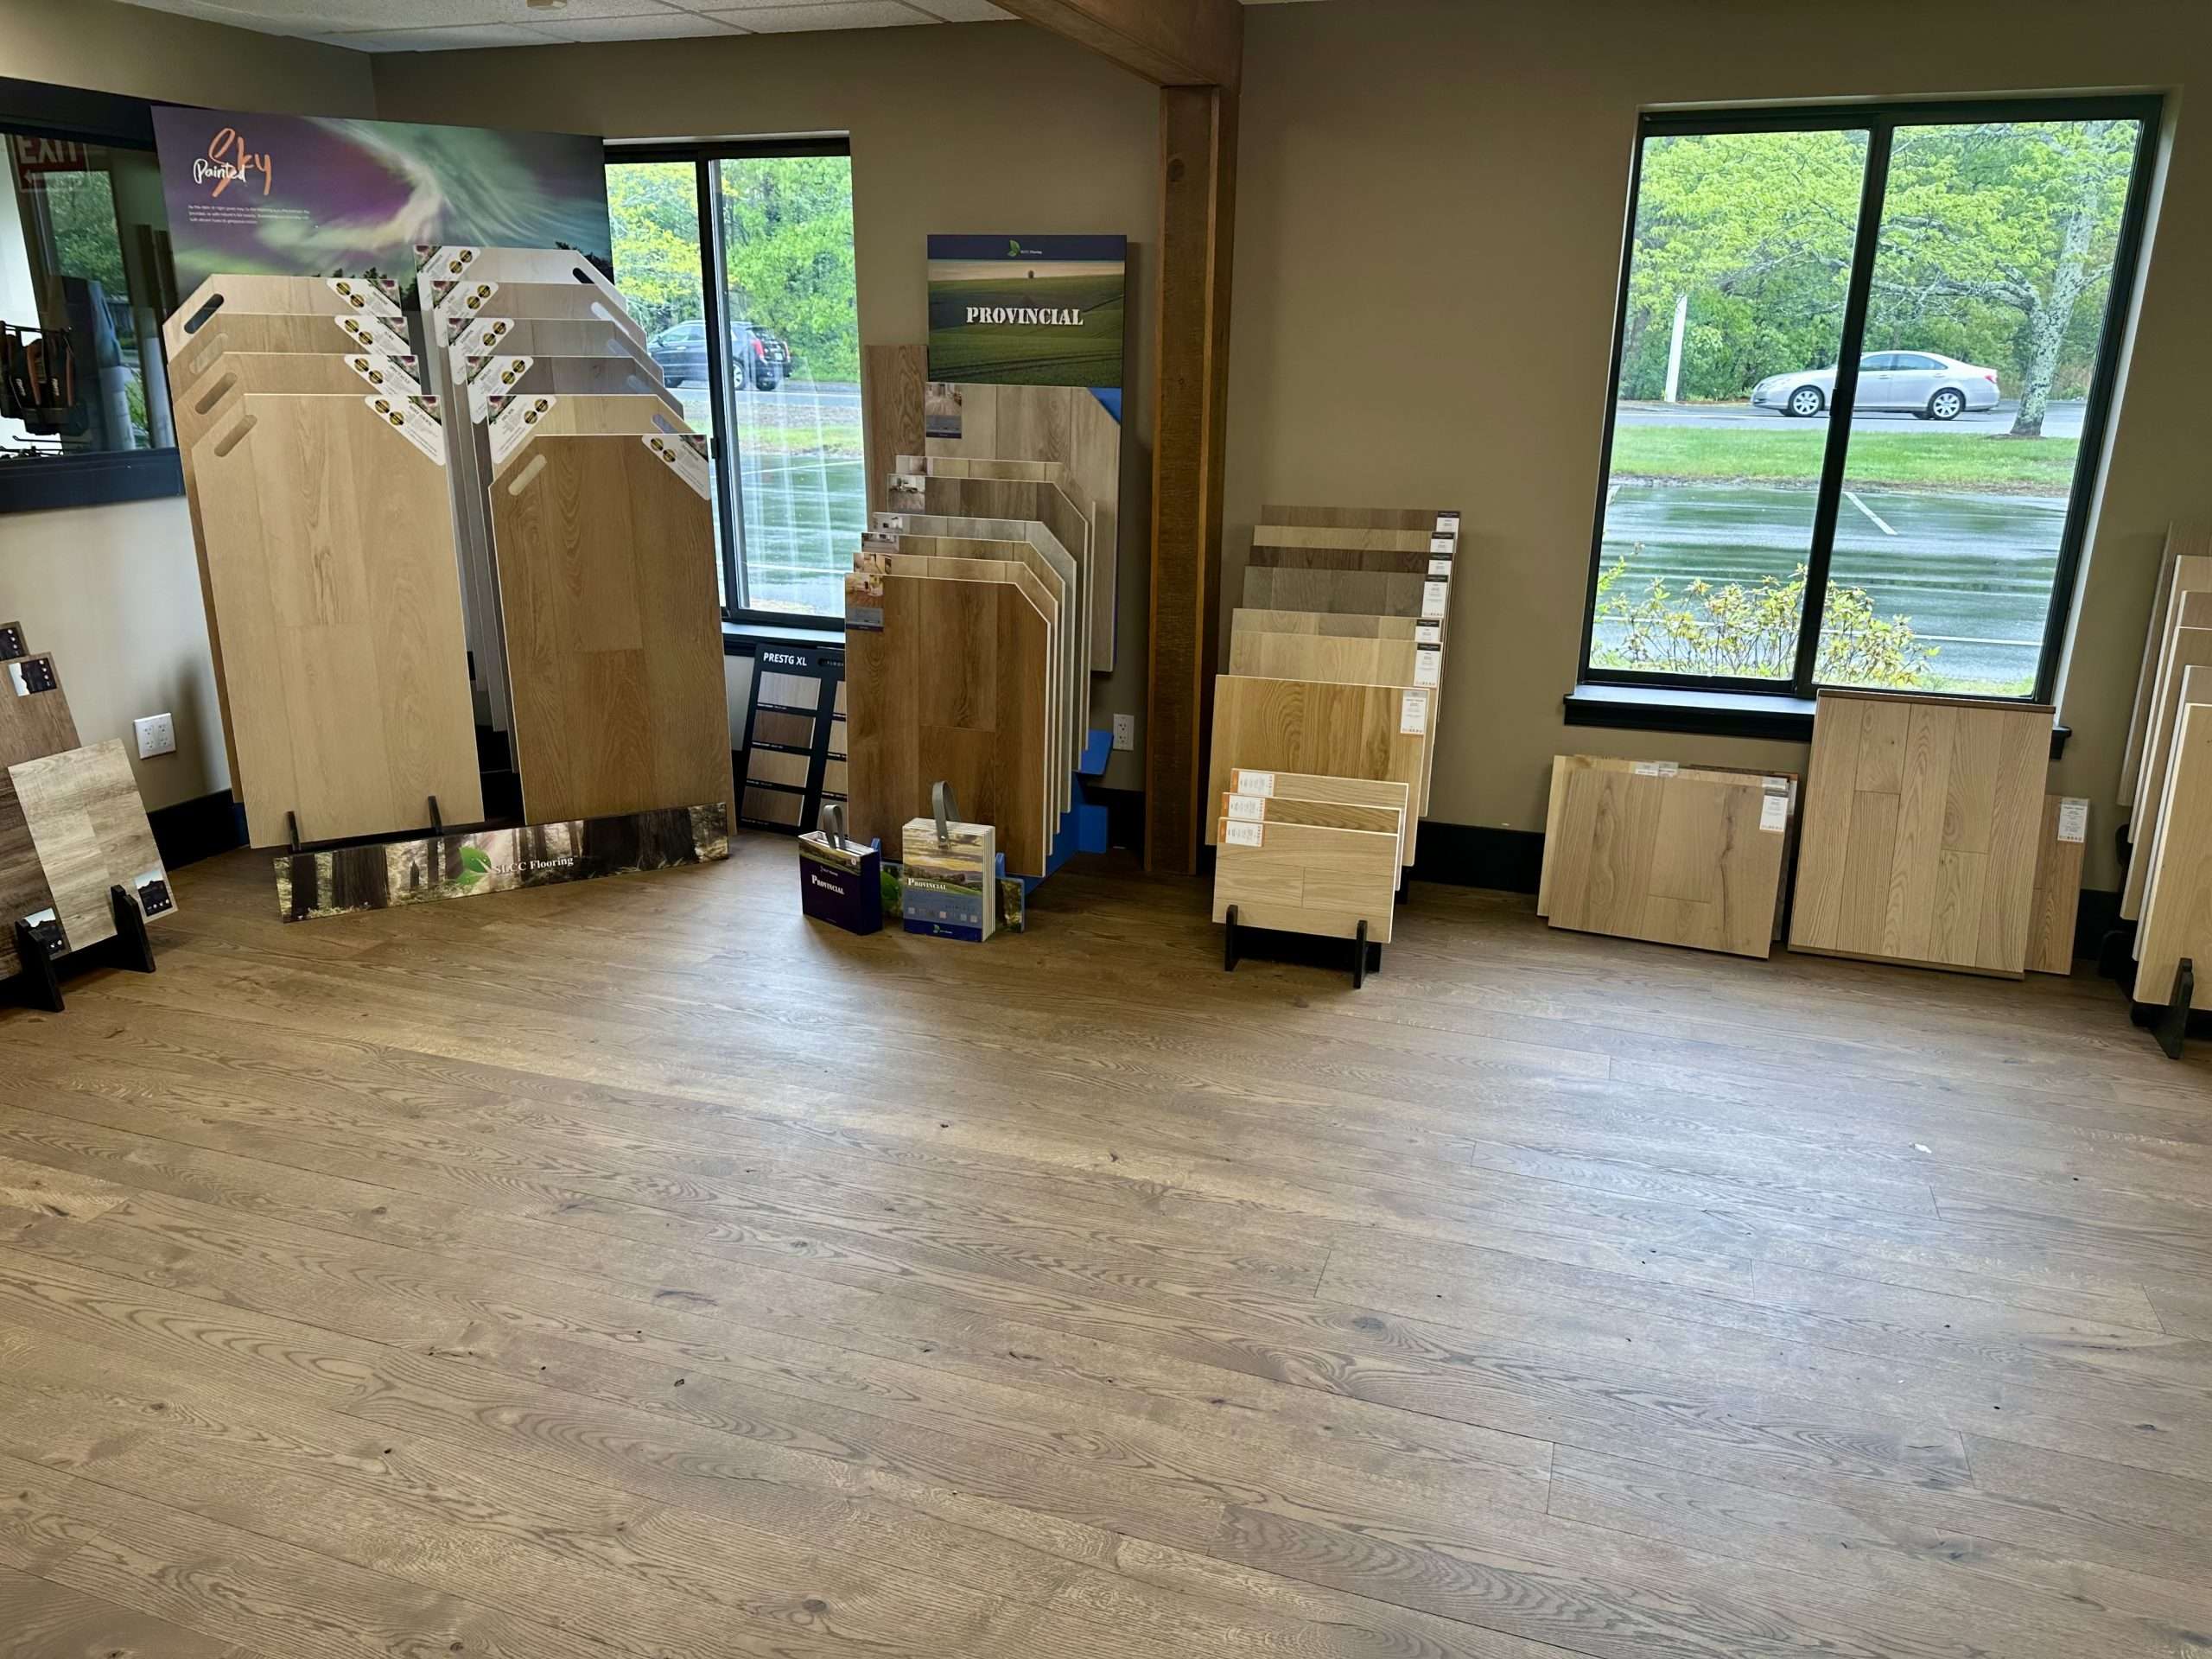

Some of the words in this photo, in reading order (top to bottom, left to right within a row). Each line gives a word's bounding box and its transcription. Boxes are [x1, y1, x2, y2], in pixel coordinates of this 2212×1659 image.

[16, 137, 78, 163] EXIT
[194, 158, 246, 184] Painted
[208, 127, 272, 197] Sky
[966, 307, 1084, 326] PROVINCIAL
[763, 652, 795, 664] PRESTG
[796, 656, 808, 666] XL
[494, 861, 527, 874] SLCC
[530, 857, 575, 870] Flooring
[811, 874, 845, 895] PROVINCIAL
[907, 877, 948, 891] PROVINCIAL
